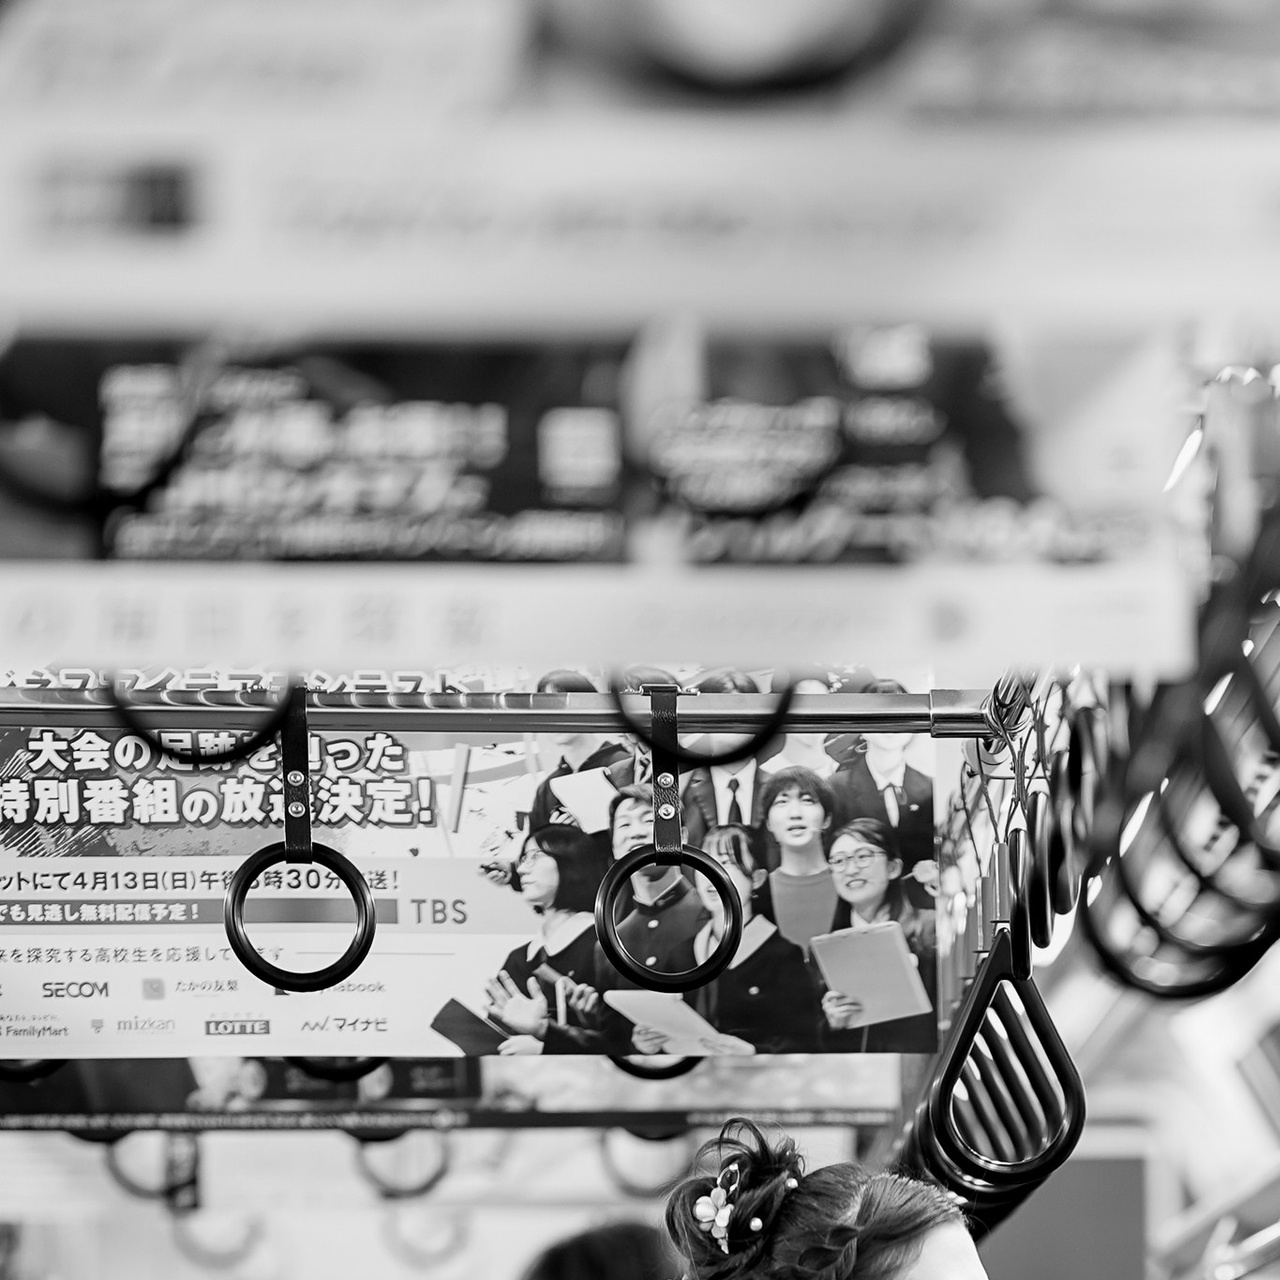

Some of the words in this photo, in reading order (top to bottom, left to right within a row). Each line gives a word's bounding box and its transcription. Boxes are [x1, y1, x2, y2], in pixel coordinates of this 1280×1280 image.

[28, 731, 405, 771] 大会の足跡をった
[410, 899, 468, 924] TBS
[42, 981, 109, 998] SECOM
[6, 1024, 69, 1038] FamilyMart
[117, 1015, 176, 1031] mizkan
[207, 1021, 268, 1034] LOTTE
[333, 1017, 388, 1032] マイナビ
